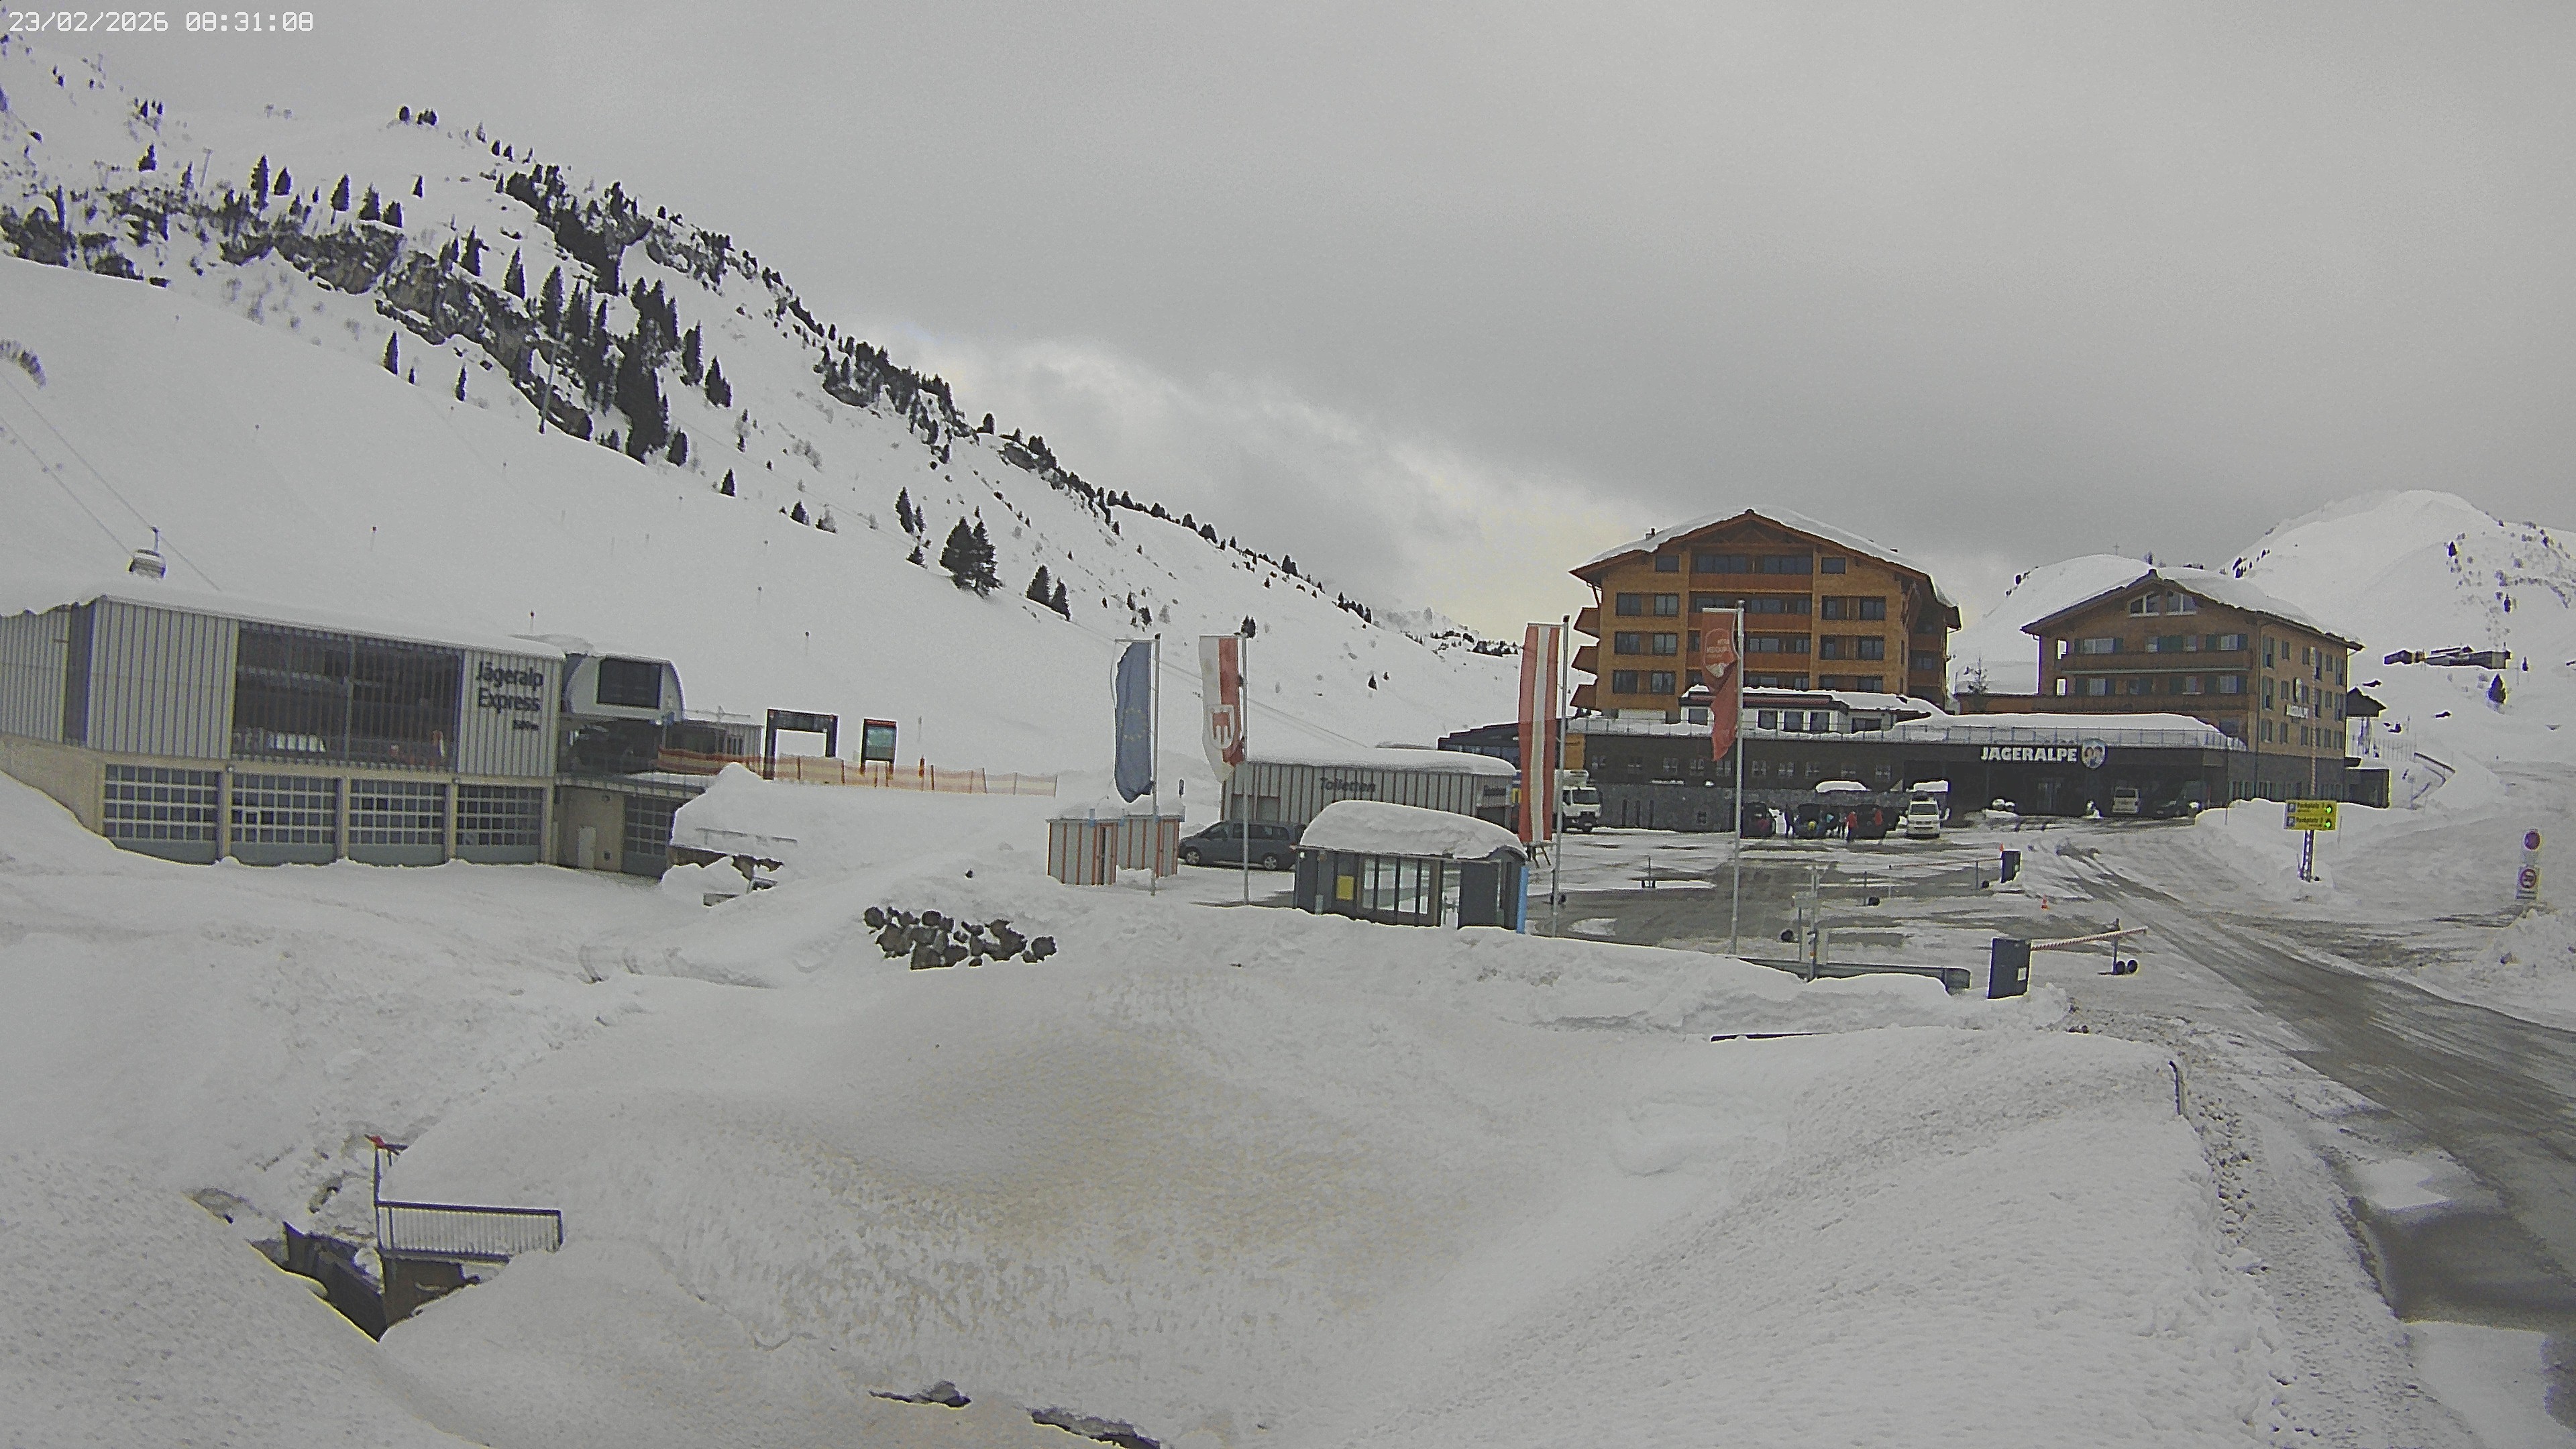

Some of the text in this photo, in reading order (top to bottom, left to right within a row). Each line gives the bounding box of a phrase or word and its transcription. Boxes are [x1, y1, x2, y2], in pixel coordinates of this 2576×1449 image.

[476, 661, 543, 691] Jägeralp
[479, 687, 541, 714] Express
[1320, 777, 1376, 792] Toiletten
